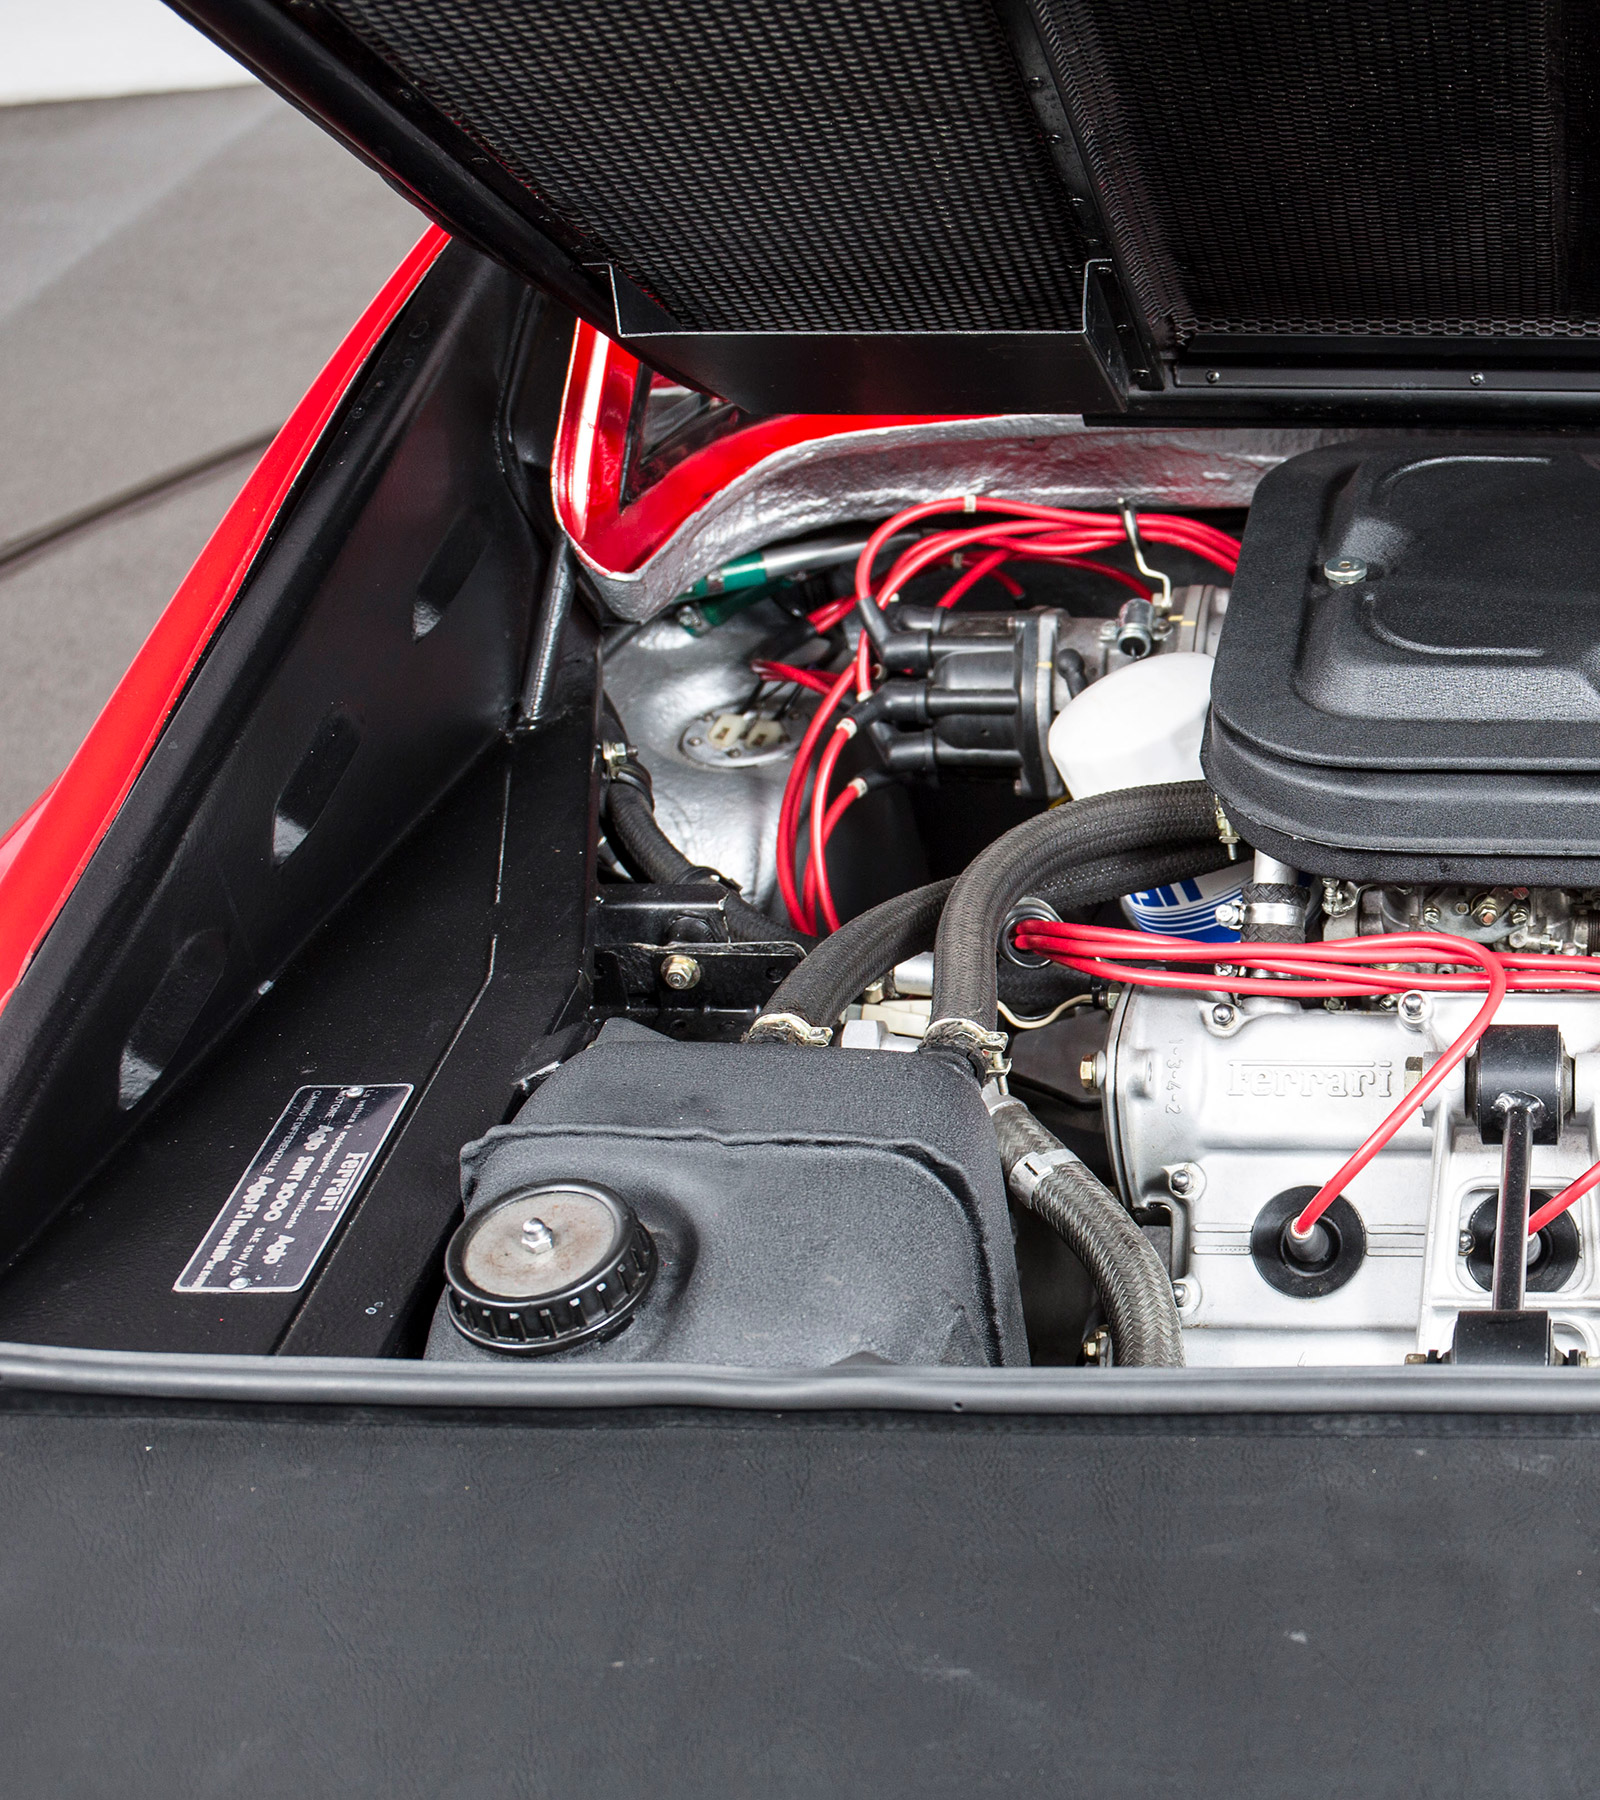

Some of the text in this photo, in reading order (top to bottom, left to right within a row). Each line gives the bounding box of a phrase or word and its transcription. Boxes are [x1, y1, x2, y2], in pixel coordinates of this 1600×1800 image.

[1226, 1060, 1393, 1098] Ferrari
[347, 1099, 367, 1122] vettura
[303, 1125, 335, 1151] Agip
[314, 1131, 347, 1173] equipaggiata
[284, 1156, 314, 1181] SINT
[307, 1175, 322, 1187] con
[314, 1152, 369, 1211] Ferrari
[242, 1176, 275, 1203] Agip
[260, 1182, 299, 1221] 2000
[283, 1189, 315, 1228] lubrificante
[247, 1227, 265, 1242] SAE
[262, 1235, 295, 1264] Agip
